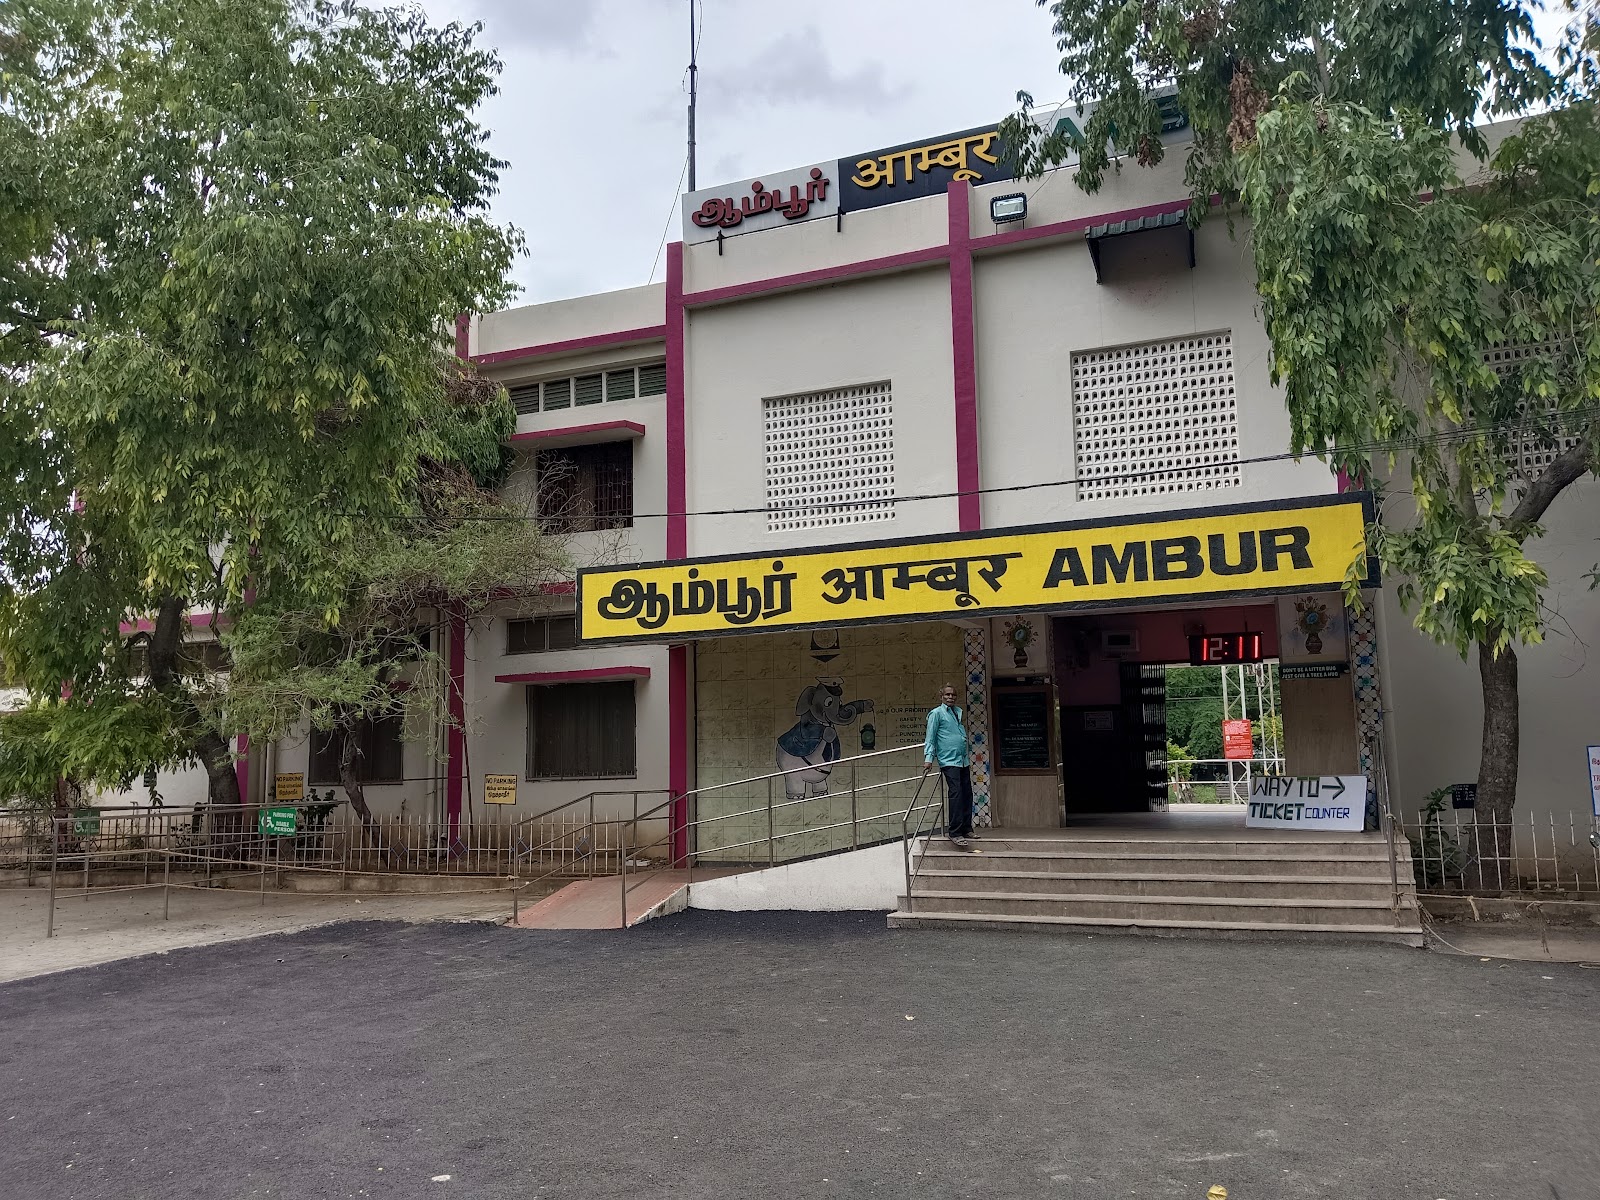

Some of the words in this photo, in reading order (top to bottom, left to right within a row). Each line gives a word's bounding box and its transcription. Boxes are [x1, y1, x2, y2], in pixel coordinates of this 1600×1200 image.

[851, 131, 1000, 190] आम्बूर
[691, 167, 830, 228] ஆம்பூர்
[821, 552, 1023, 608] आम्बूर
[1042, 525, 1314, 589] AMBUR
[597, 560, 798, 630] ஆம்பூர்
[1203, 635, 1259, 661] 12:11
[1249, 802, 1305, 820] TICKET
[1305, 807, 1350, 819] COUNTER
[1251, 776, 1294, 797] WAY
[1297, 777, 1320, 798] TO
